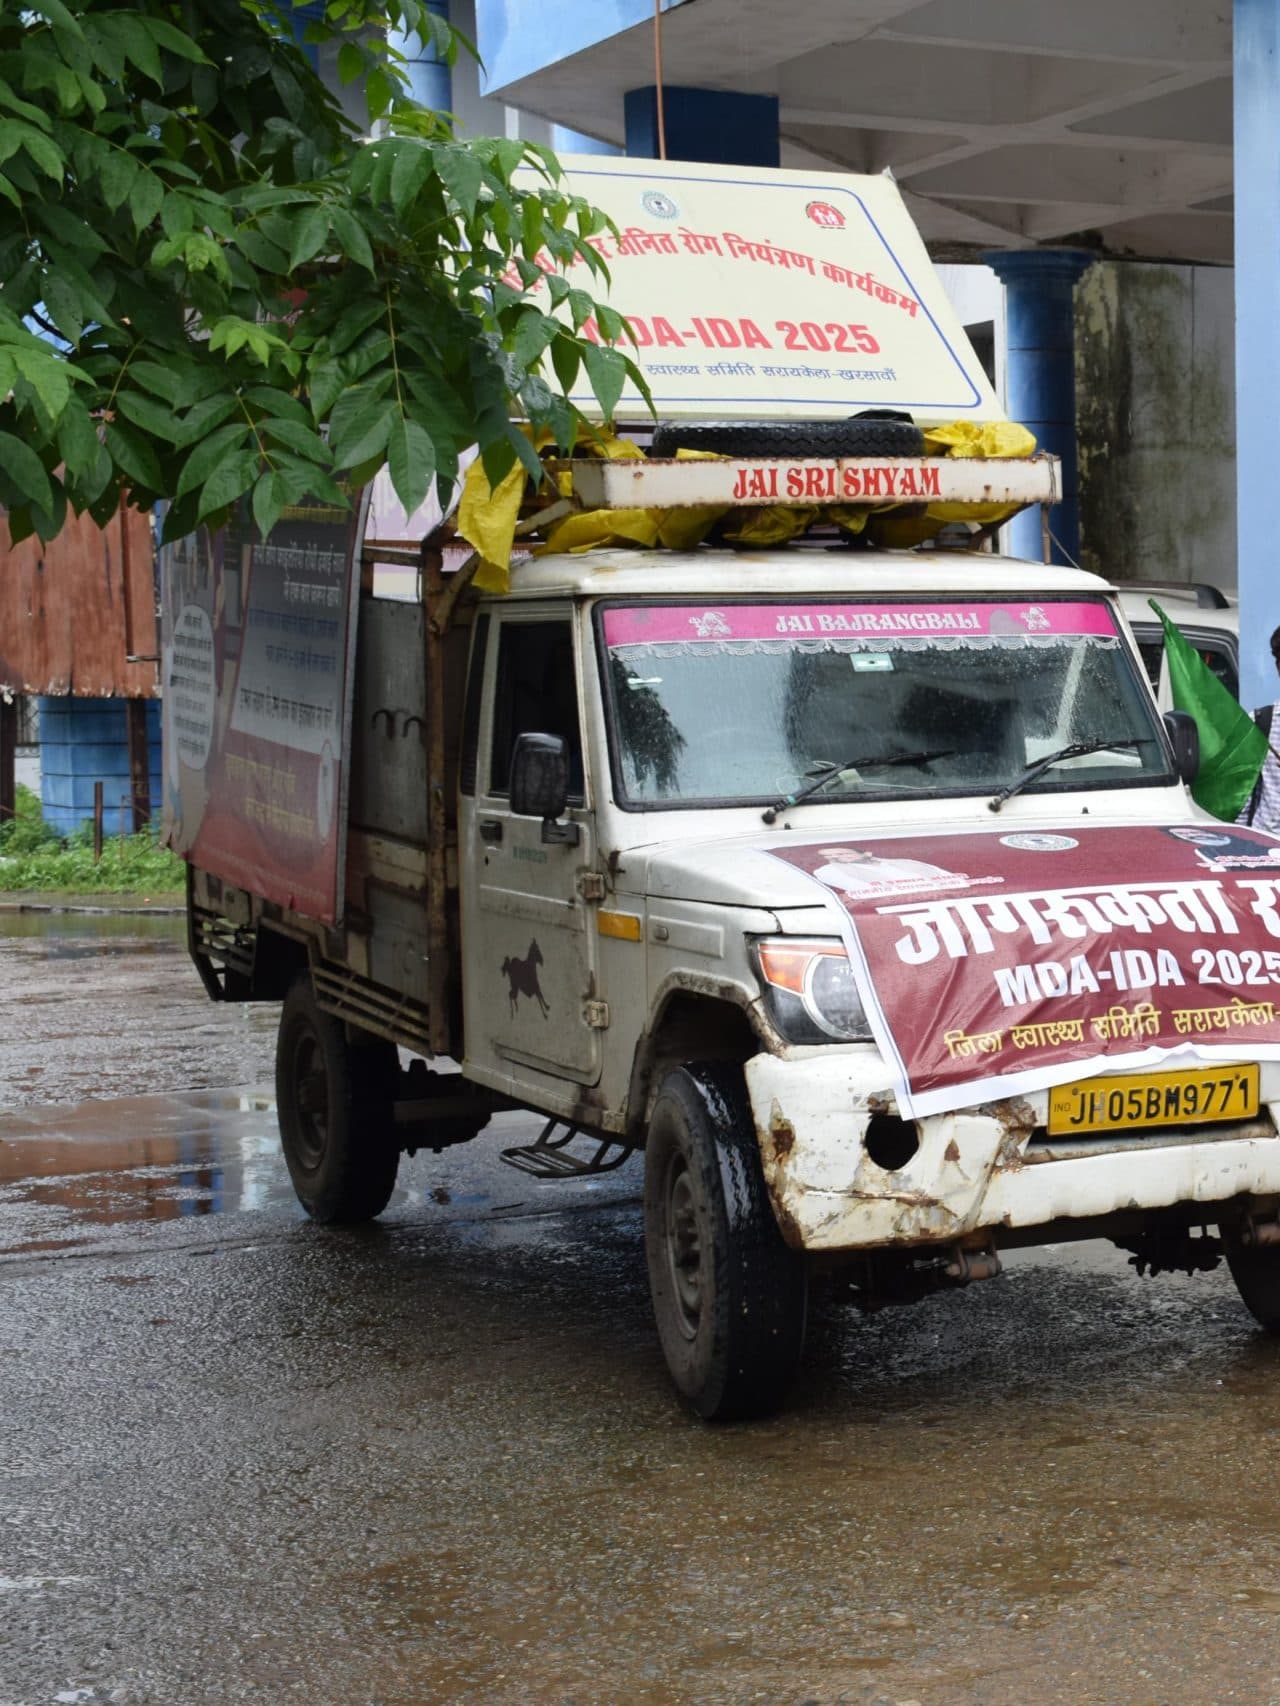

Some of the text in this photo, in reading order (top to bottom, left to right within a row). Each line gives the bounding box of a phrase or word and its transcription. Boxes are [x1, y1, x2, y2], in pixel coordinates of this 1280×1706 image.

[678, 226, 724, 257] रोग
[723, 232, 817, 276] नियंत्रण
[776, 321, 881, 354] 2025
[705, 362, 755, 377] समिति
[732, 467, 942, 499] JAI SRI SHYAM
[775, 613, 981, 632] JAI BAJRANGBALI
[993, 948, 1186, 1007] MDA-IDA
[943, 1028, 1003, 1060] जिला
[1009, 1018, 1084, 1050] स्वास्थ्य
[1090, 1002, 1162, 1040] समिति
[1070, 1077, 1249, 1125] JH05BM9771
